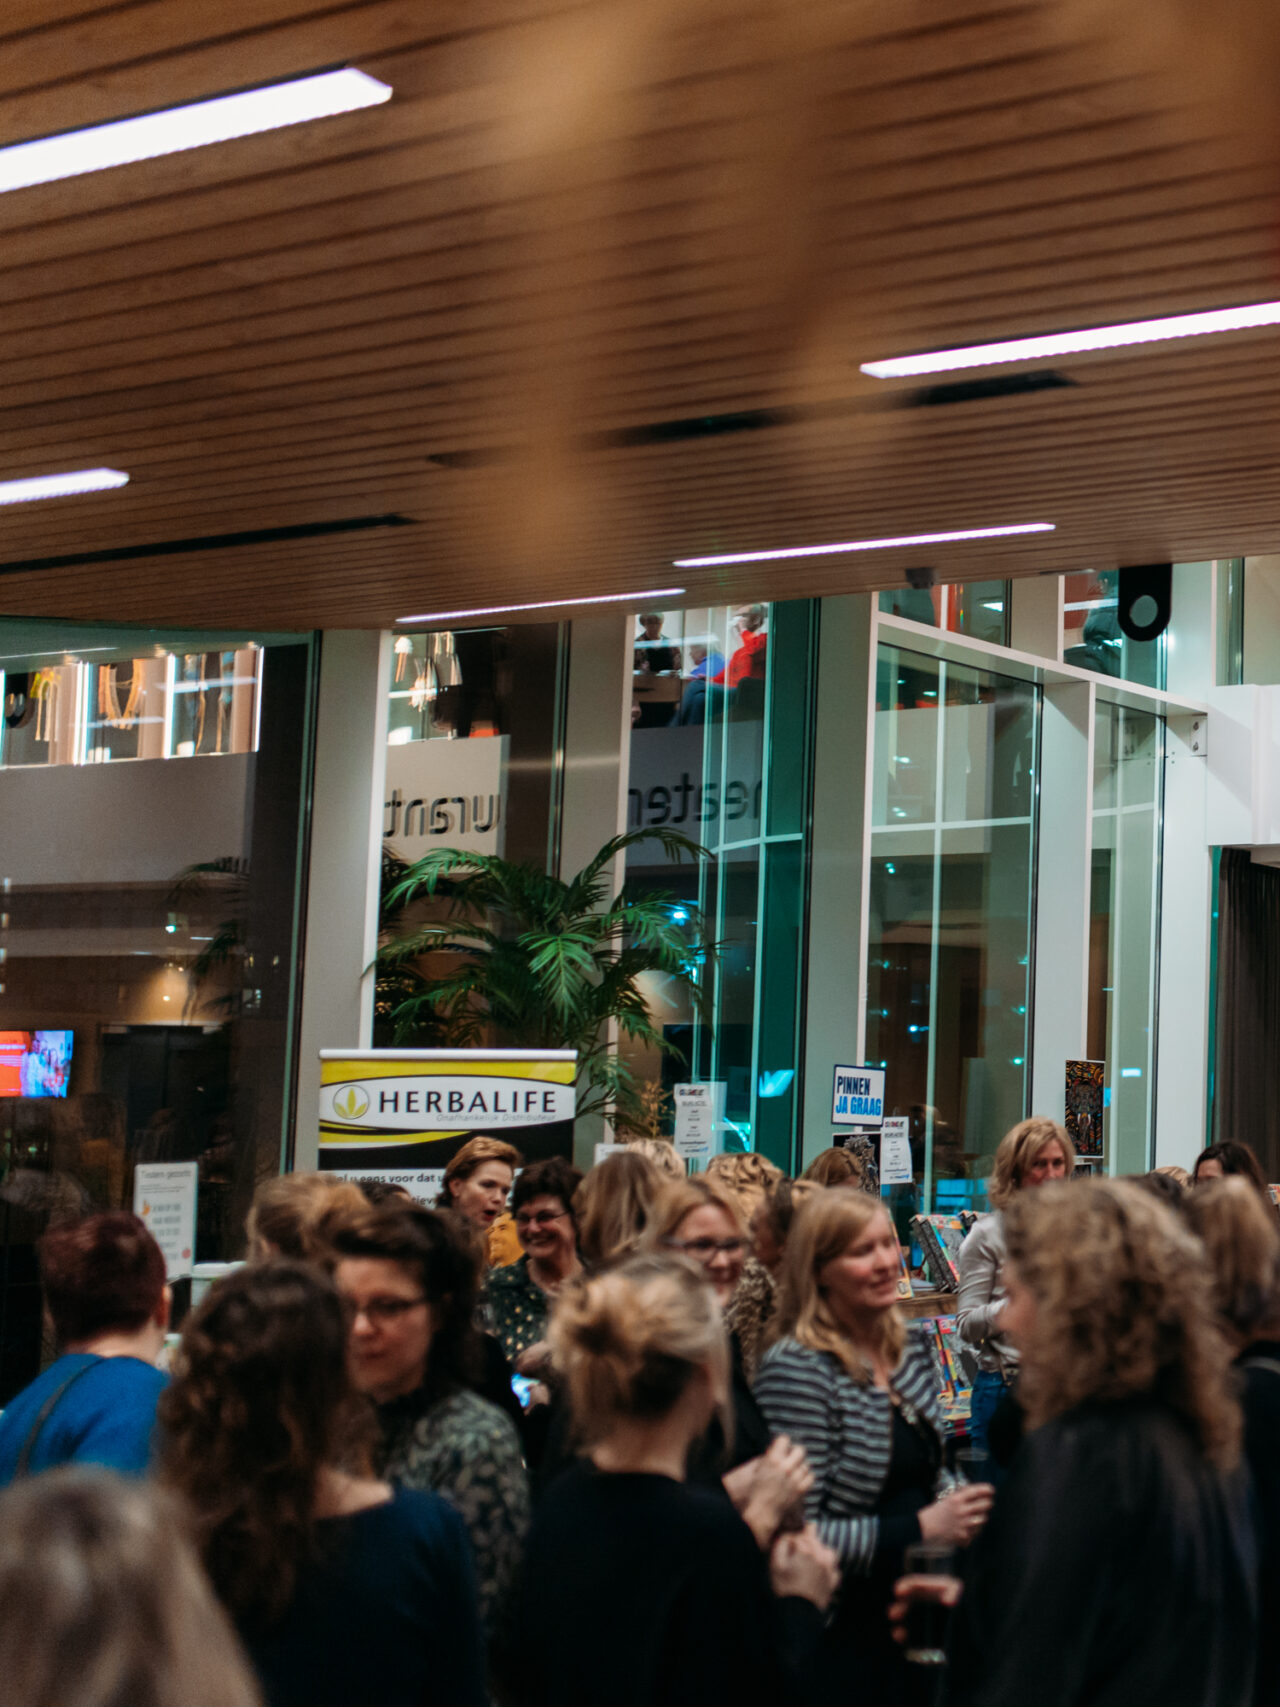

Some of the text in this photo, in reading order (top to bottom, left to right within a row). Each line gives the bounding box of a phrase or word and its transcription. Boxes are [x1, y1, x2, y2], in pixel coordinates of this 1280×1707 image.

[837, 1076, 871, 1096] PINNEN
[379, 1091, 556, 1113] HERBALIFE
[835, 1096, 882, 1116] JA GRAAG
[389, 1175, 414, 1183] voor
[416, 1173, 435, 1183] dat
